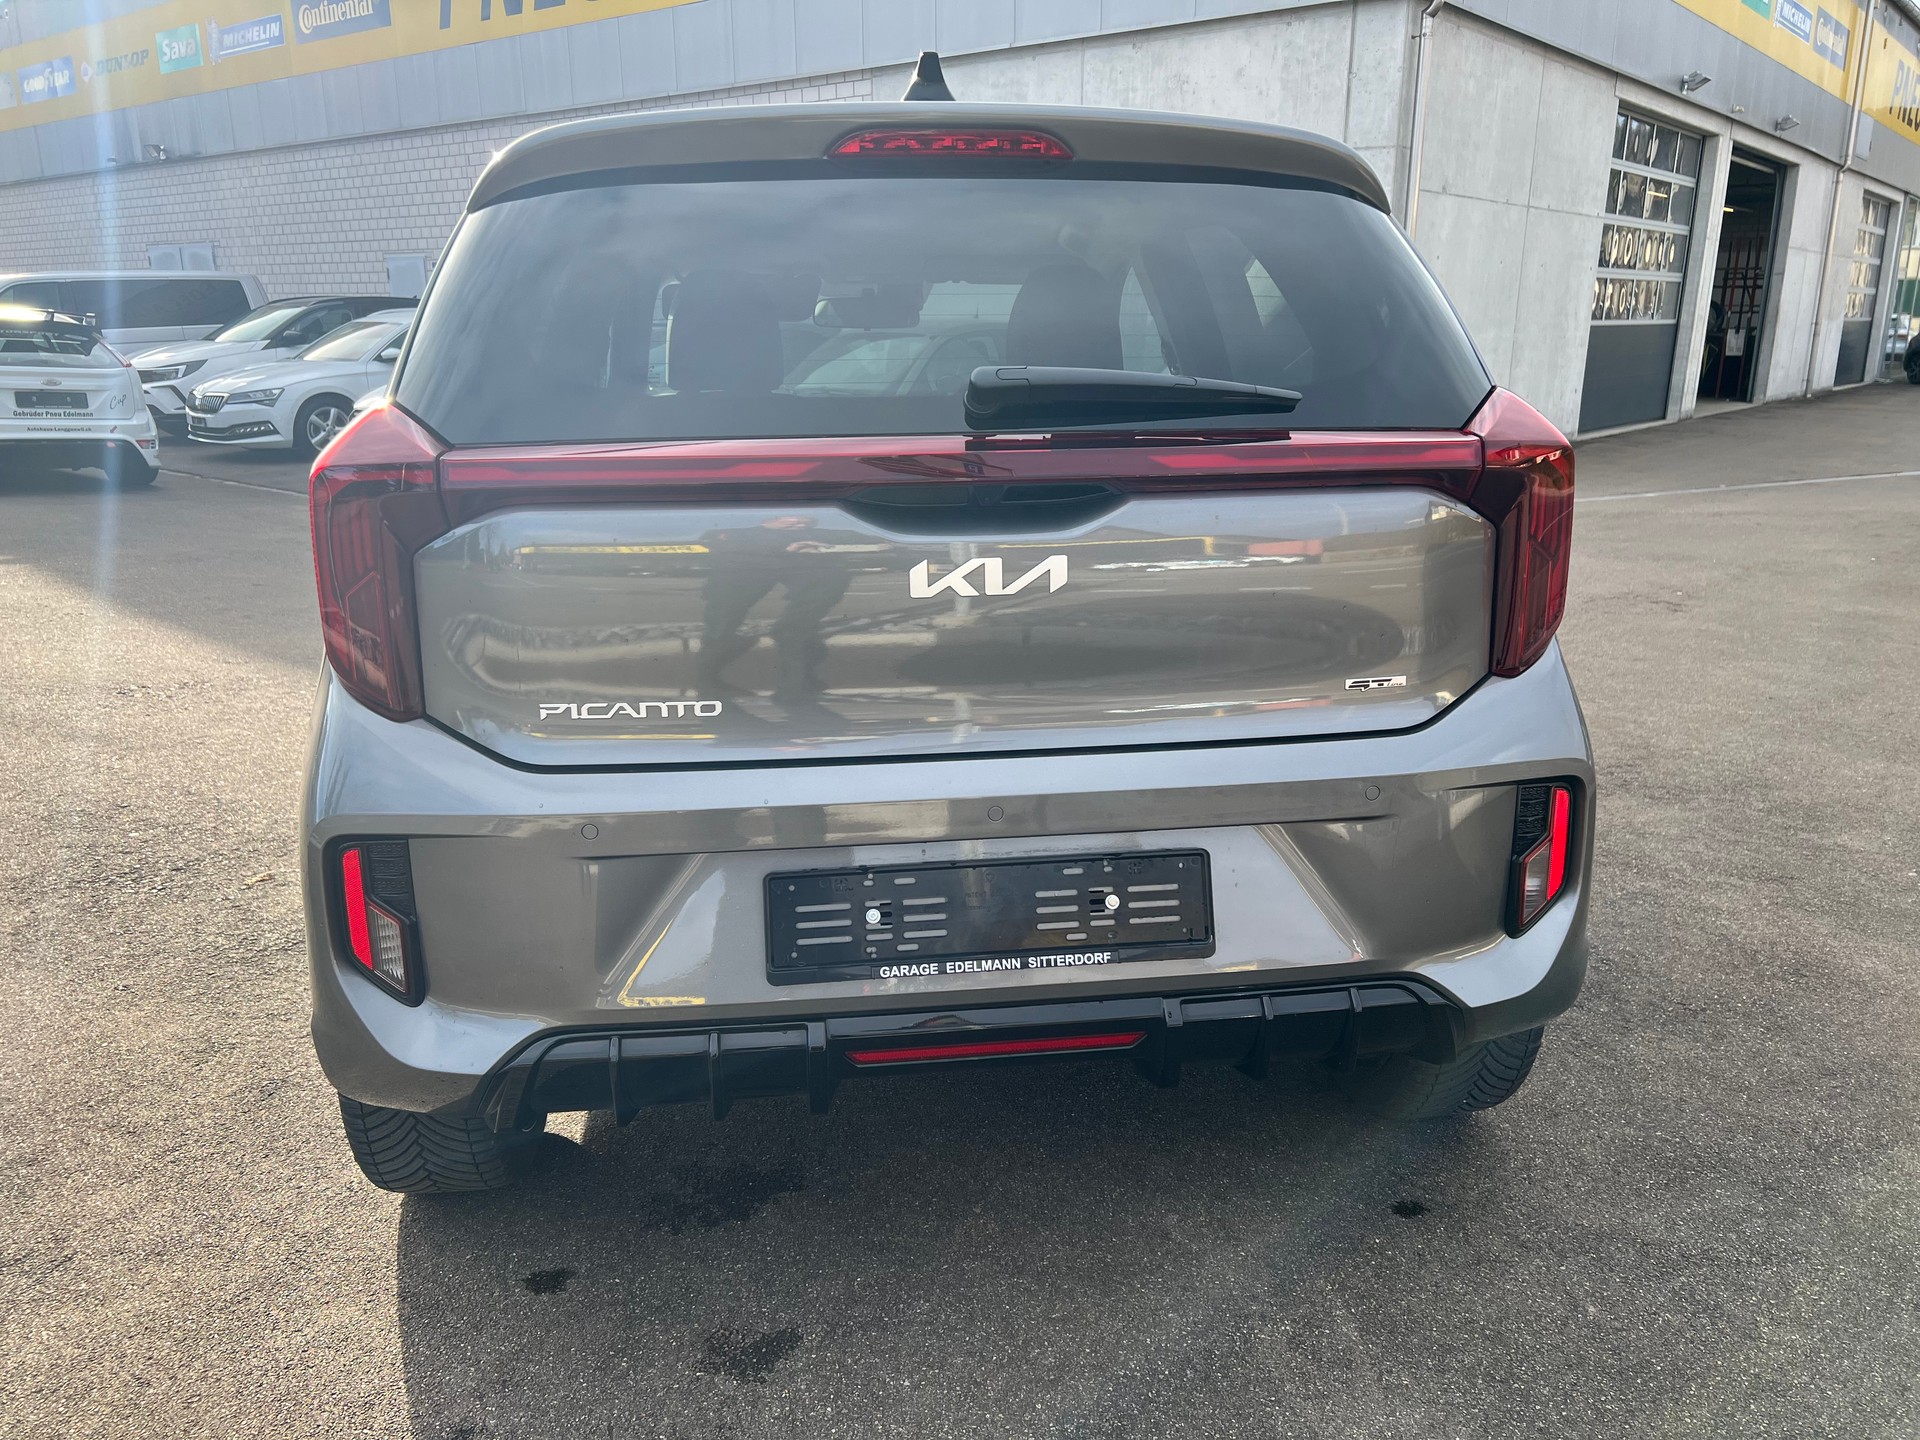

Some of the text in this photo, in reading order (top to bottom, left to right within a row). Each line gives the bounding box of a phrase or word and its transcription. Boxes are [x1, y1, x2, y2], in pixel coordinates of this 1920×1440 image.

[298, 0, 374, 34] Continental
[1782, 1, 1811, 34] MICHELIN
[222, 21, 281, 48] MICHELIN
[95, 48, 149, 77] DUNLOP
[162, 38, 196, 62] Sava
[12, 409, 44, 418] Gebrüder
[45, 410, 62, 418] Pneu
[909, 554, 1068, 599] KIA
[539, 700, 722, 721] PICANTO
[879, 952, 1112, 979] GARAGE EDELMANN SITTERDORF
